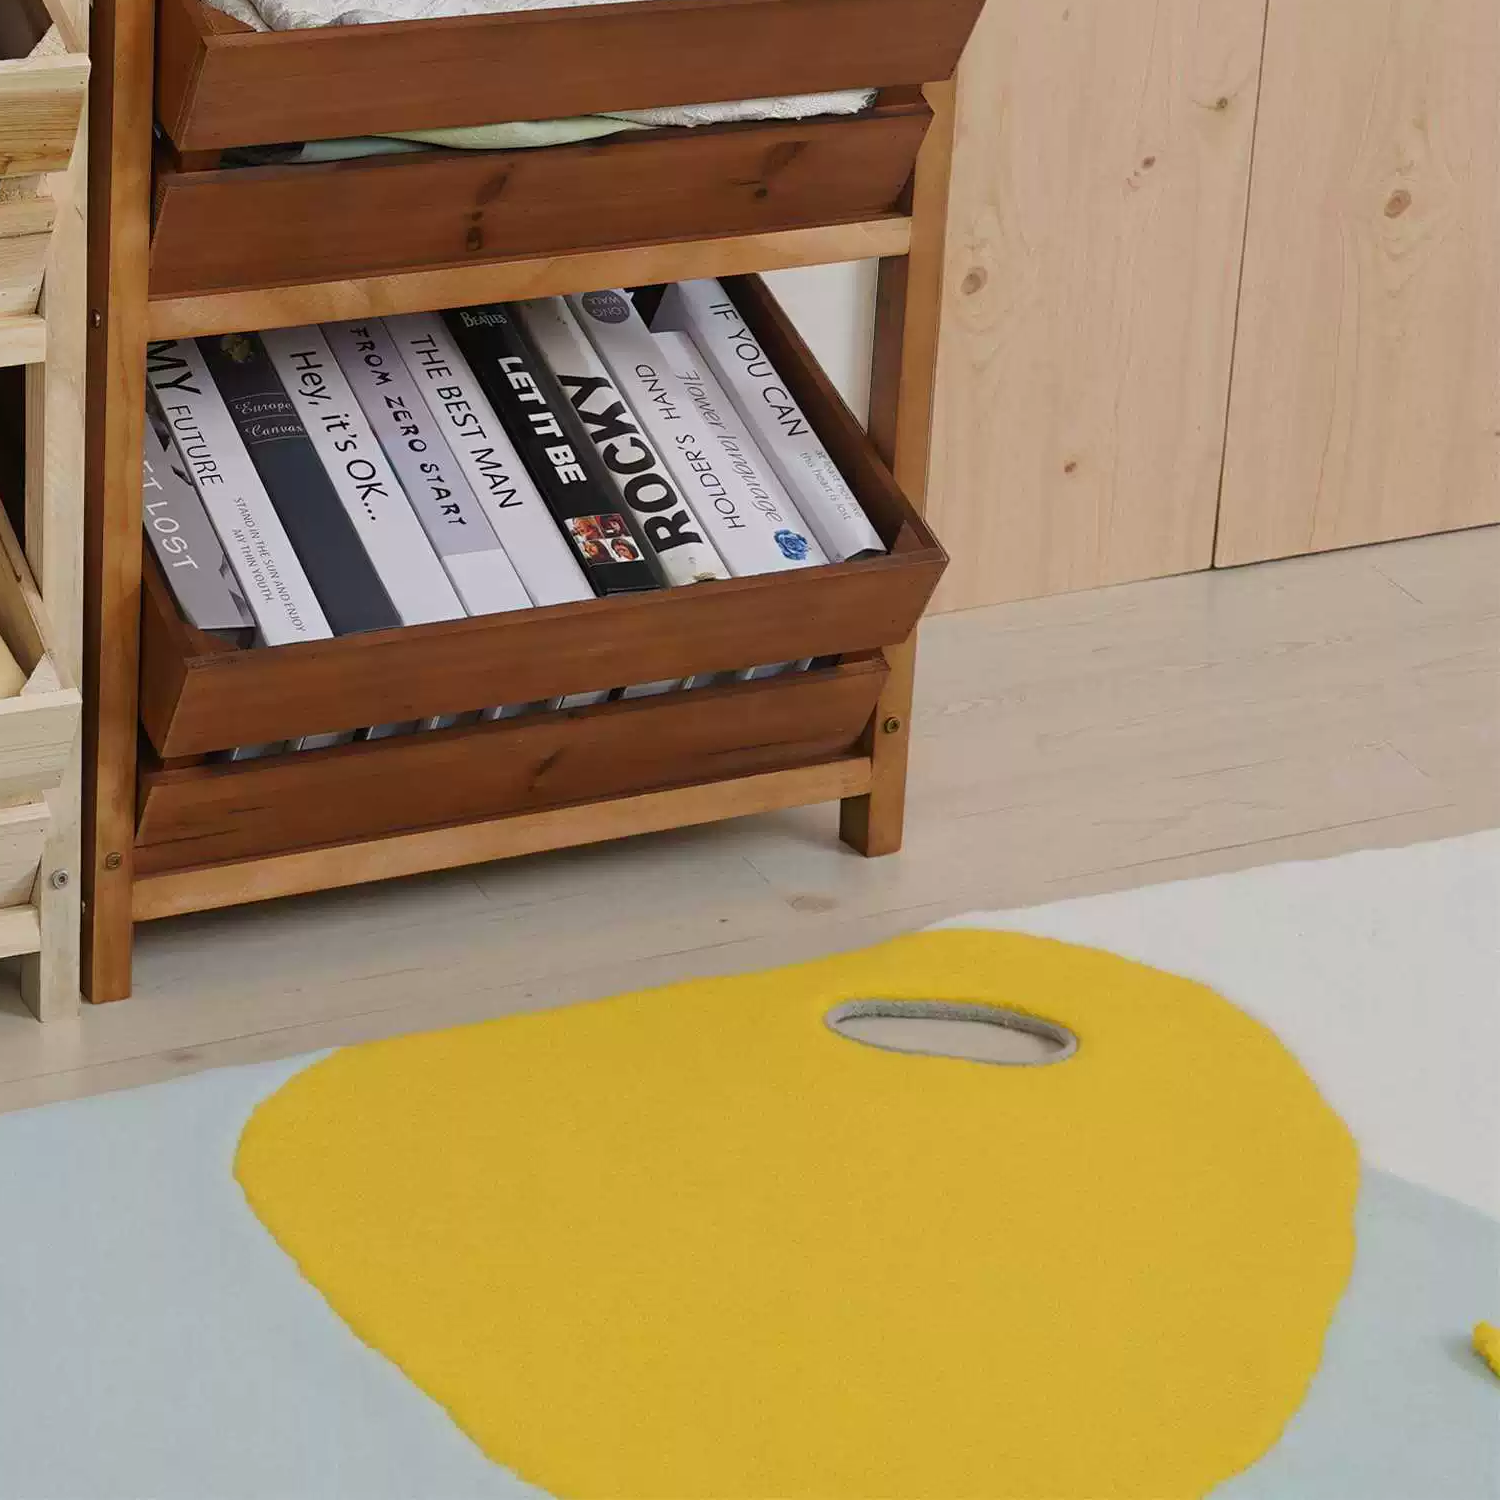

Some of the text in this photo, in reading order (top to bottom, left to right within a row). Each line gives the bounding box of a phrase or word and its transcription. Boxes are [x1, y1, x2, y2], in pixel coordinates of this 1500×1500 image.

[146, 340, 224, 487] MY FUTURE
[235, 401, 293, 415] Europe
[244, 424, 304, 437] Canvas
[289, 350, 389, 521] Hey, it's OK...
[350, 327, 468, 526] FROM ZERO START
[409, 334, 523, 509] THE BEST MAN
[497, 356, 588, 485] LET IT BE
[709, 303, 809, 436] IF YOU CAN
[556, 374, 703, 554] ROCKY
[635, 363, 746, 529] HOLDER'S HAND
[716, 434, 784, 523] language
[146, 501, 199, 569] LOST
[234, 497, 256, 528] STAND
[256, 539, 271, 557] THE
[264, 559, 280, 580] SUN
[274, 579, 291, 602] AND
[283, 601, 307, 632] ENJOY
